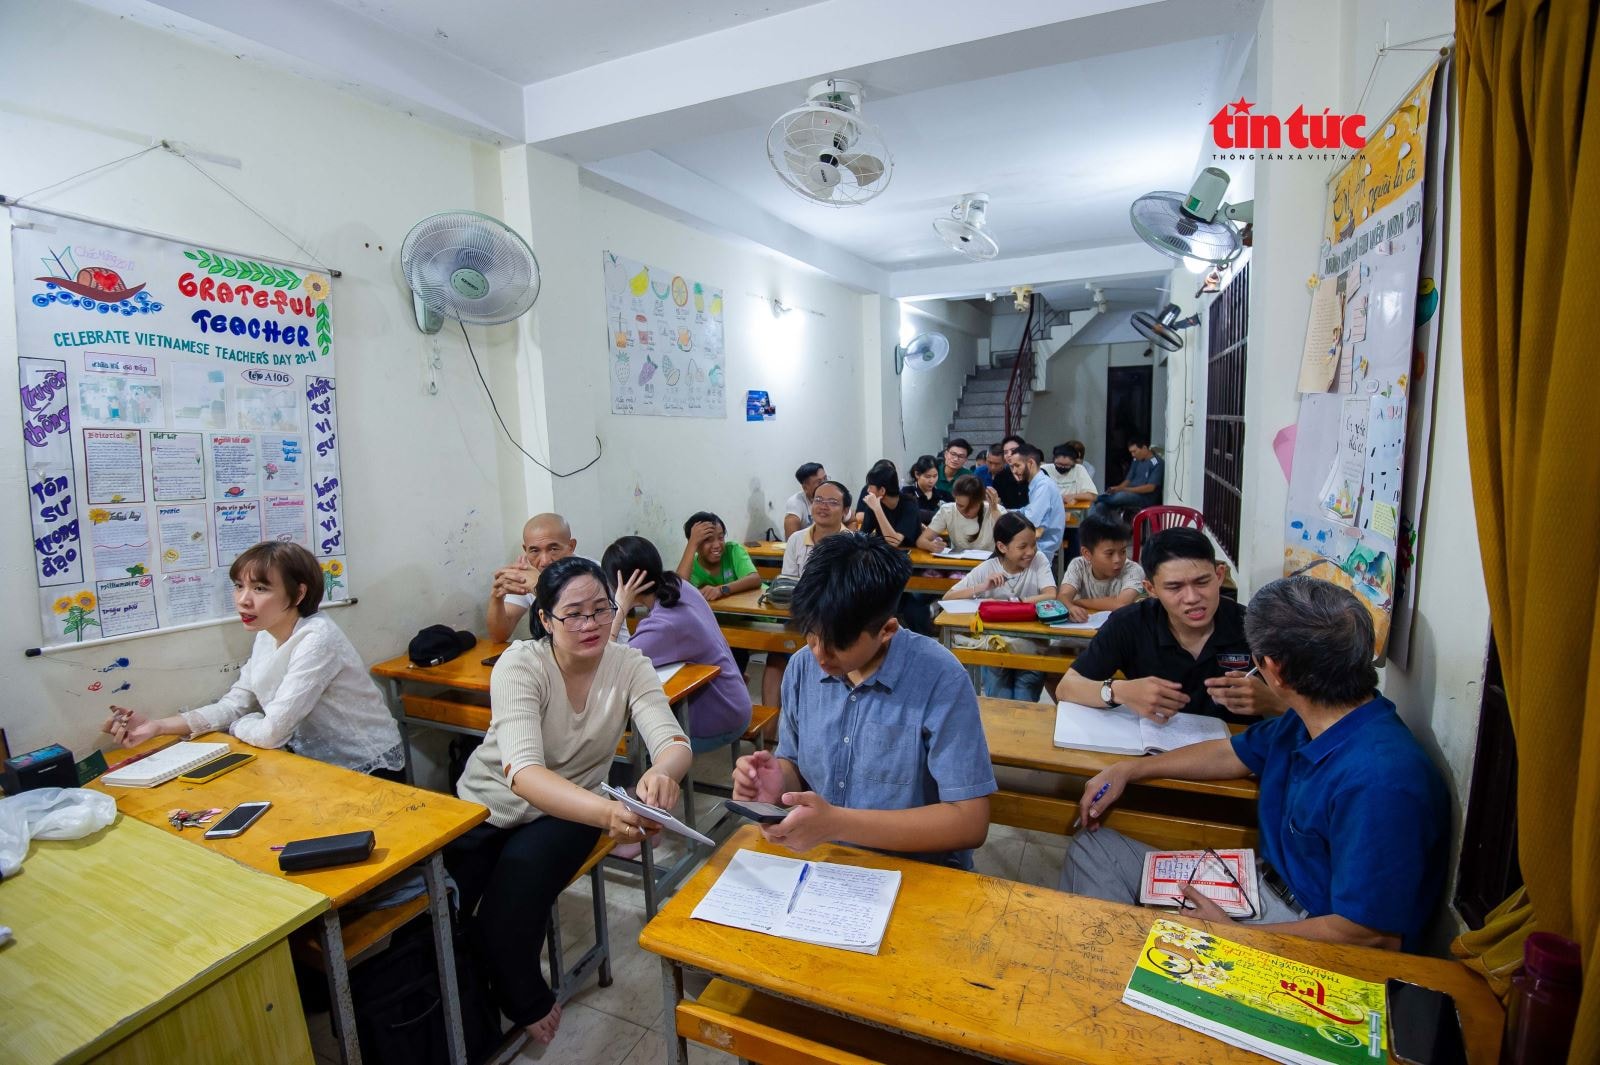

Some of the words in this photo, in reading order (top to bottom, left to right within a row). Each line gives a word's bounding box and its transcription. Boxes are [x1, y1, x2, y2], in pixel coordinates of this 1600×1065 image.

[178, 271, 315, 318] GRATEFUL
[191, 308, 311, 348] TEACHER
[53, 329, 131, 348] CELEBRATE
[135, 331, 210, 356] VIETNAMESE
[273, 350, 293, 366] DAY
[294, 350, 317, 365] 20-11
[264, 372, 289, 383] A106
